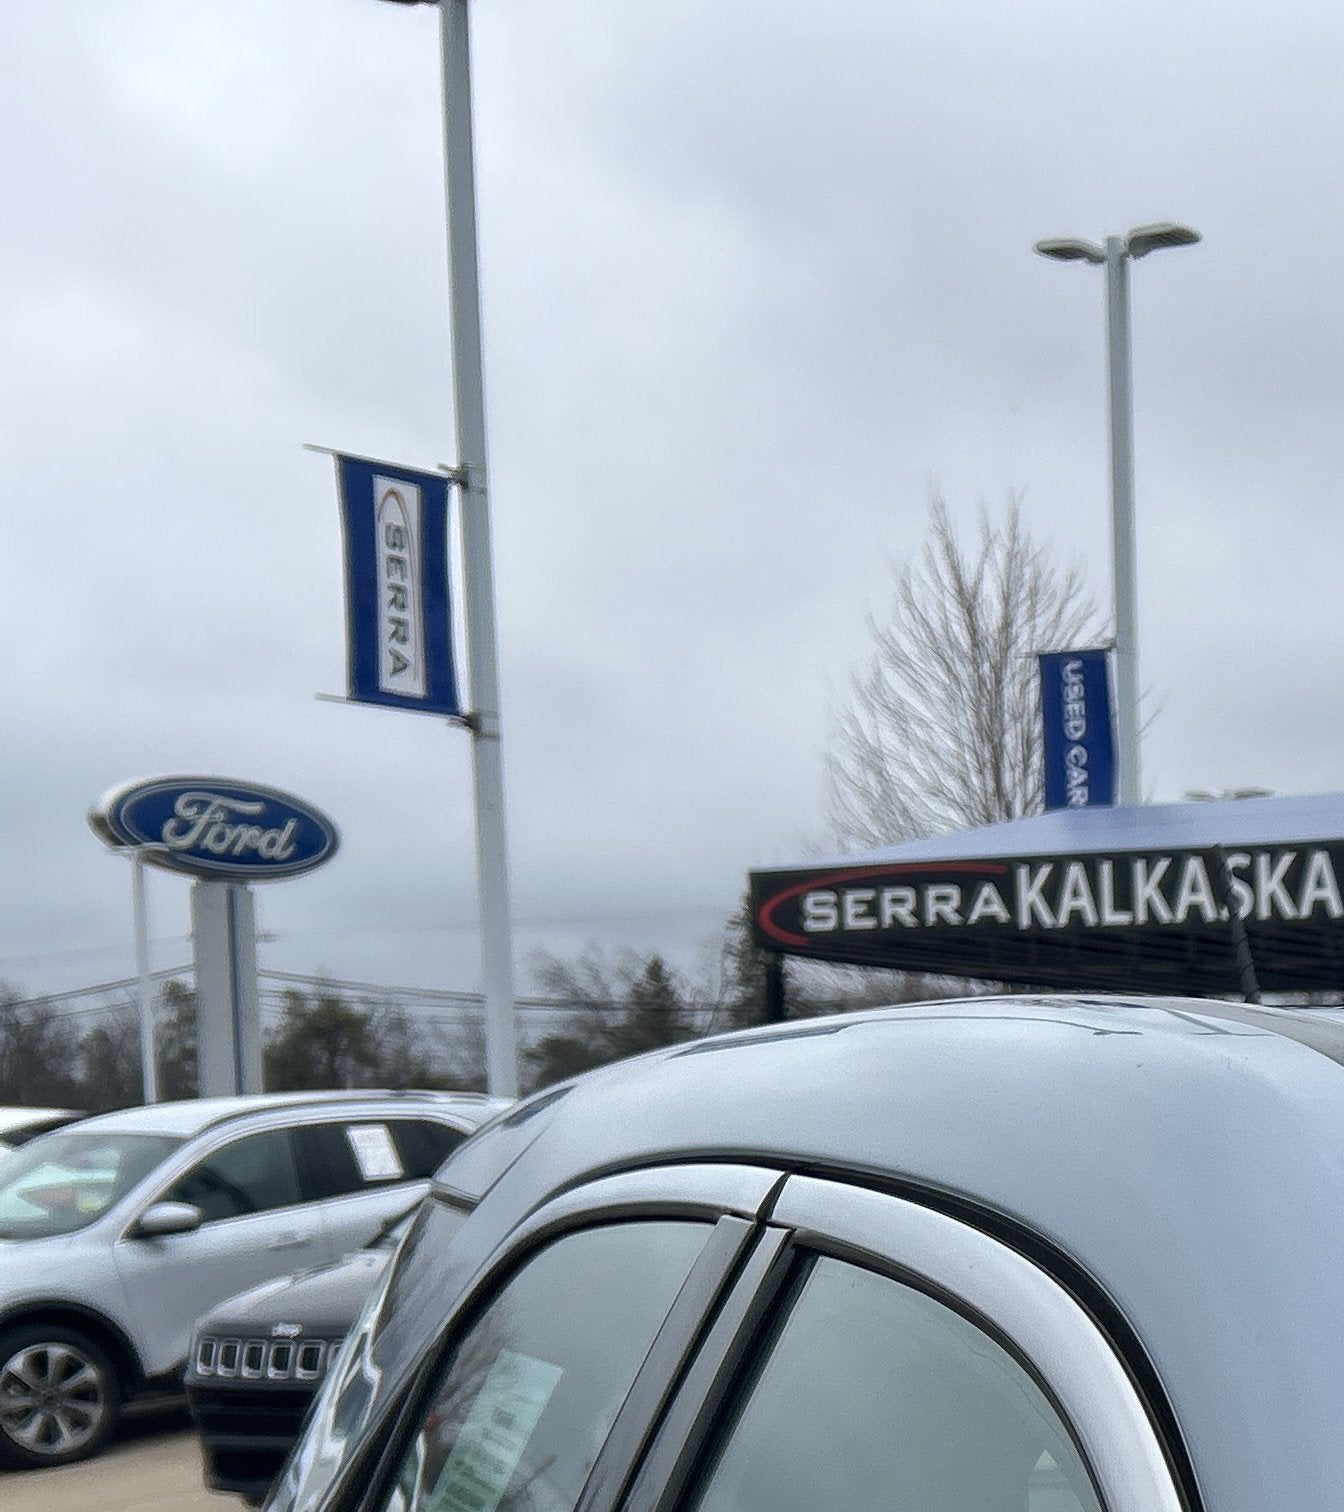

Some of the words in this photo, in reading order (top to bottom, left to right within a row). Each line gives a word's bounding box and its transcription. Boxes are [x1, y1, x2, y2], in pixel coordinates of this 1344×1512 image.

[384, 522, 409, 677] SERRA
[1062, 660, 1086, 741] USED
[162, 791, 298, 861] Ford
[803, 881, 1011, 932] SERRA
[1017, 850, 1344, 930] KALKASKA
